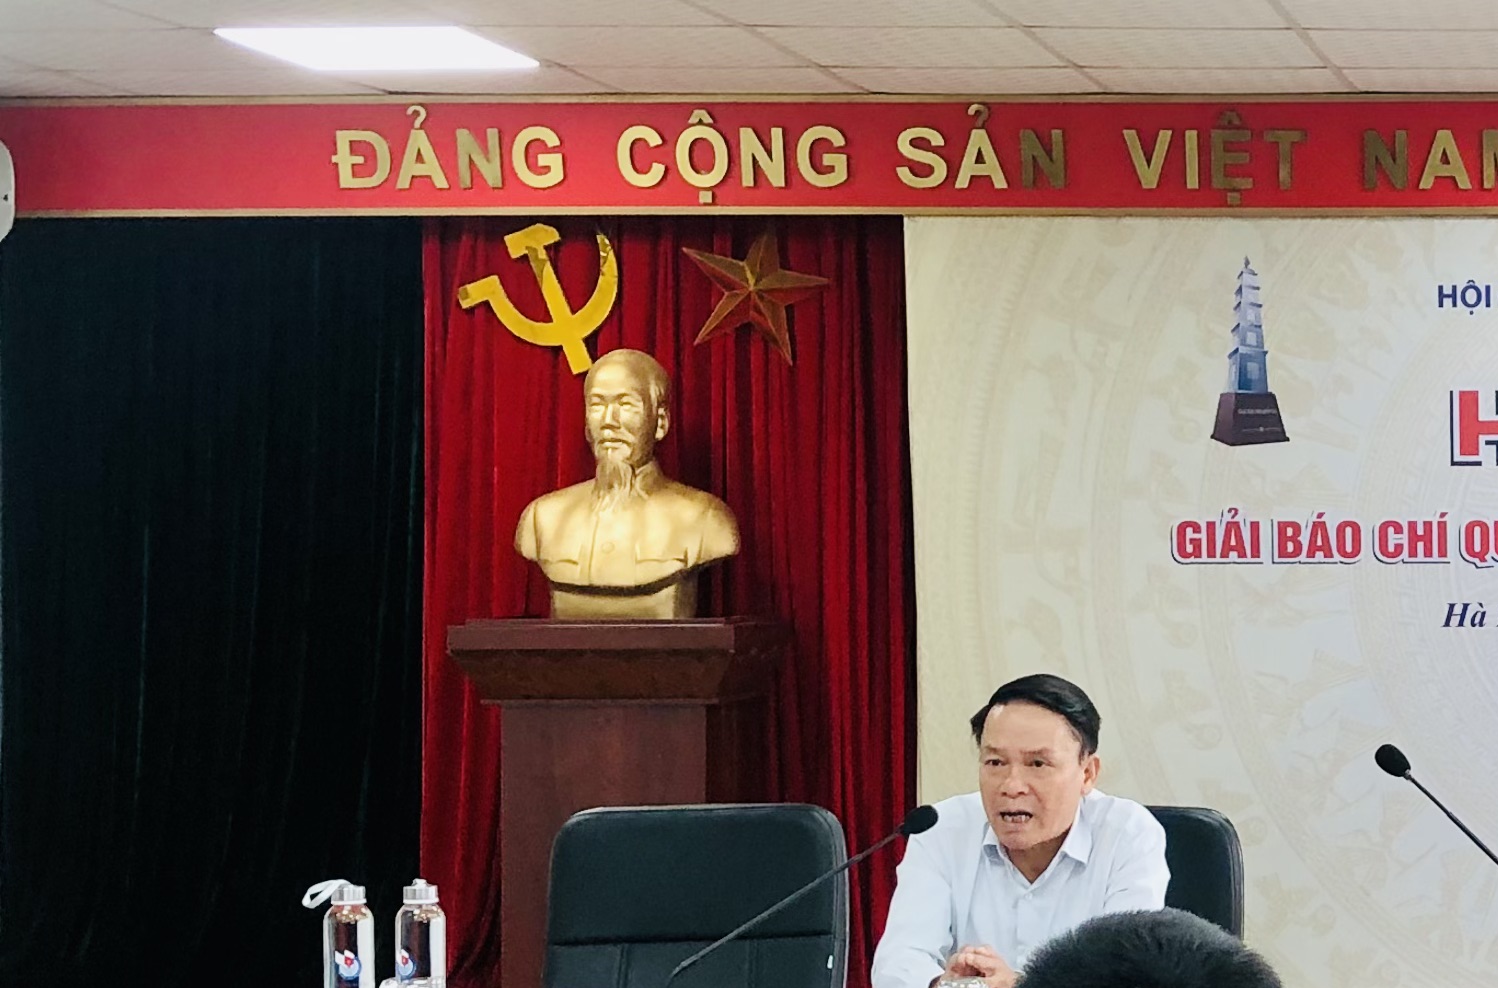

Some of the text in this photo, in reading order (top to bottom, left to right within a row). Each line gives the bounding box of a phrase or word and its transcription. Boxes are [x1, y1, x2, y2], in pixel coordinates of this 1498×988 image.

[332, 104, 564, 190] ĐẢNG
[617, 108, 849, 204] CỘNG
[895, 103, 1066, 191] SẢN
[1121, 110, 1308, 206] VIỆT
[1437, 279, 1491, 315] HỘI
[1173, 507, 1262, 562] GIẢI
[1273, 511, 1362, 562] BÁO
[1374, 511, 1450, 562] CHÍ
[1442, 602, 1487, 628] Hà
